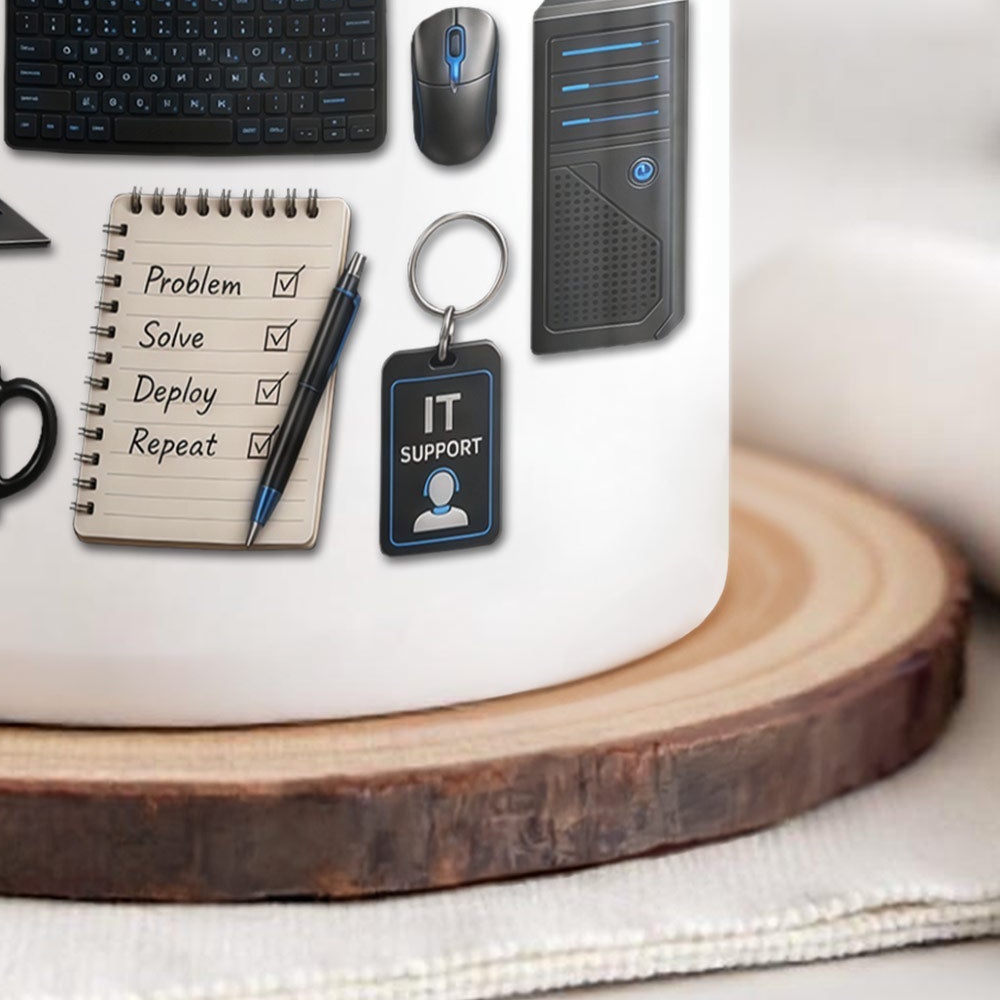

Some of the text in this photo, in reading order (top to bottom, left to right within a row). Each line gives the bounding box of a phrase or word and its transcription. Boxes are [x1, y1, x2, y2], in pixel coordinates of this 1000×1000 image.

[143, 265, 241, 295] Problem
[138, 320, 205, 349] Solve
[133, 374, 217, 415] Deploy
[424, 392, 462, 434] IT
[128, 427, 218, 464] Repeat
[400, 436, 483, 464] SUPPORT
